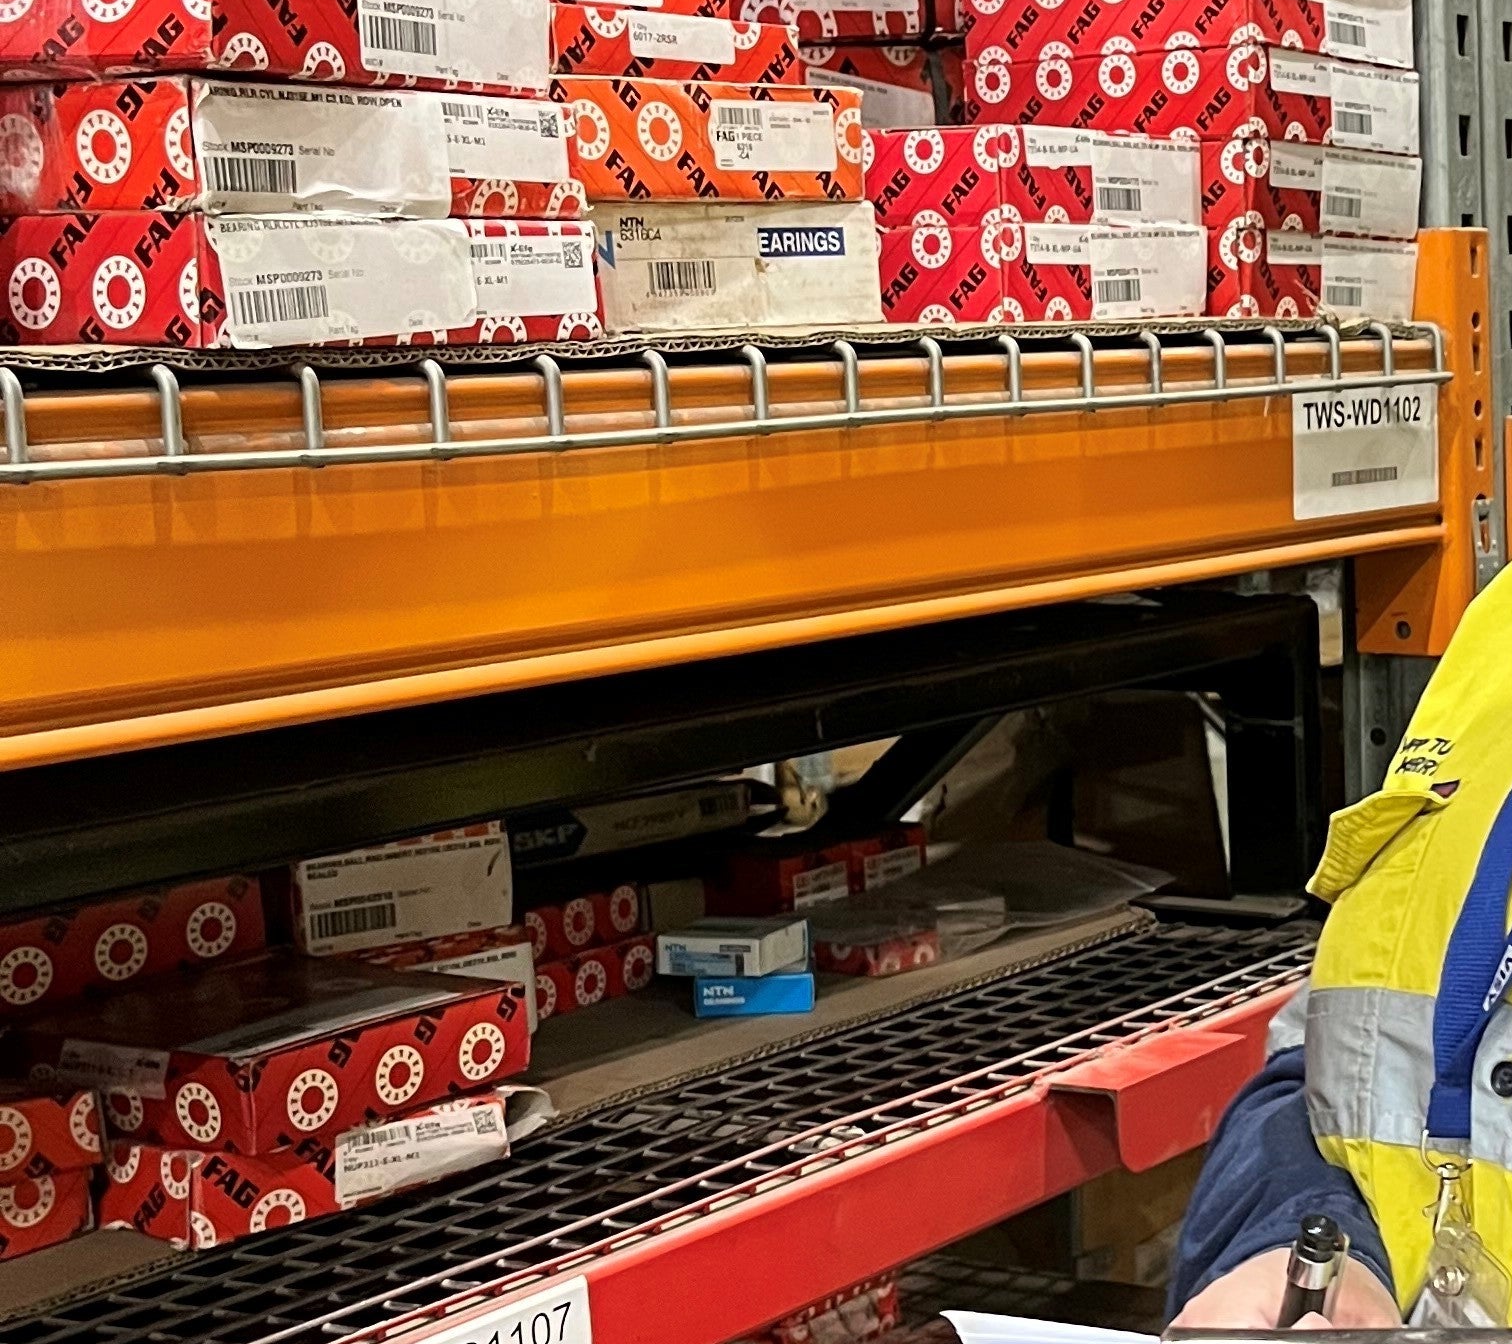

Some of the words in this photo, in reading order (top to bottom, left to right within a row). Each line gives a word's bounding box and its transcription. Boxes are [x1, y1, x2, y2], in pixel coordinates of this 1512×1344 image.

[1005, 5, 1039, 50] FAG
[1066, 0, 1101, 44] FAG
[1016, 96, 1043, 125] AG
[1133, 89, 1168, 133] FAG
[1196, 85, 1231, 131] FAG
[231, 141, 295, 156] MSP0009273
[716, 131, 735, 142] FAG
[58, 171, 93, 210] FA
[141, 167, 180, 210] FA
[872, 167, 911, 217] FAG
[941, 166, 980, 216] FAG
[1201, 180, 1226, 214] AG
[49, 213, 101, 271] FA
[134, 213, 183, 270] FA
[620, 216, 643, 228] NTN
[620, 228, 661, 241] 6316CA
[759, 230, 841, 255] EARINGS
[257, 269, 322, 287] MSP0009273
[881, 261, 919, 310] FAG
[949, 262, 987, 311] FAG
[1302, 395, 1421, 430] TWS-WD1102
[703, 985, 734, 997] NTN
[202, 1156, 260, 1209] FAG
[295, 1138, 337, 1184] FA
[133, 1184, 166, 1234] FAG
